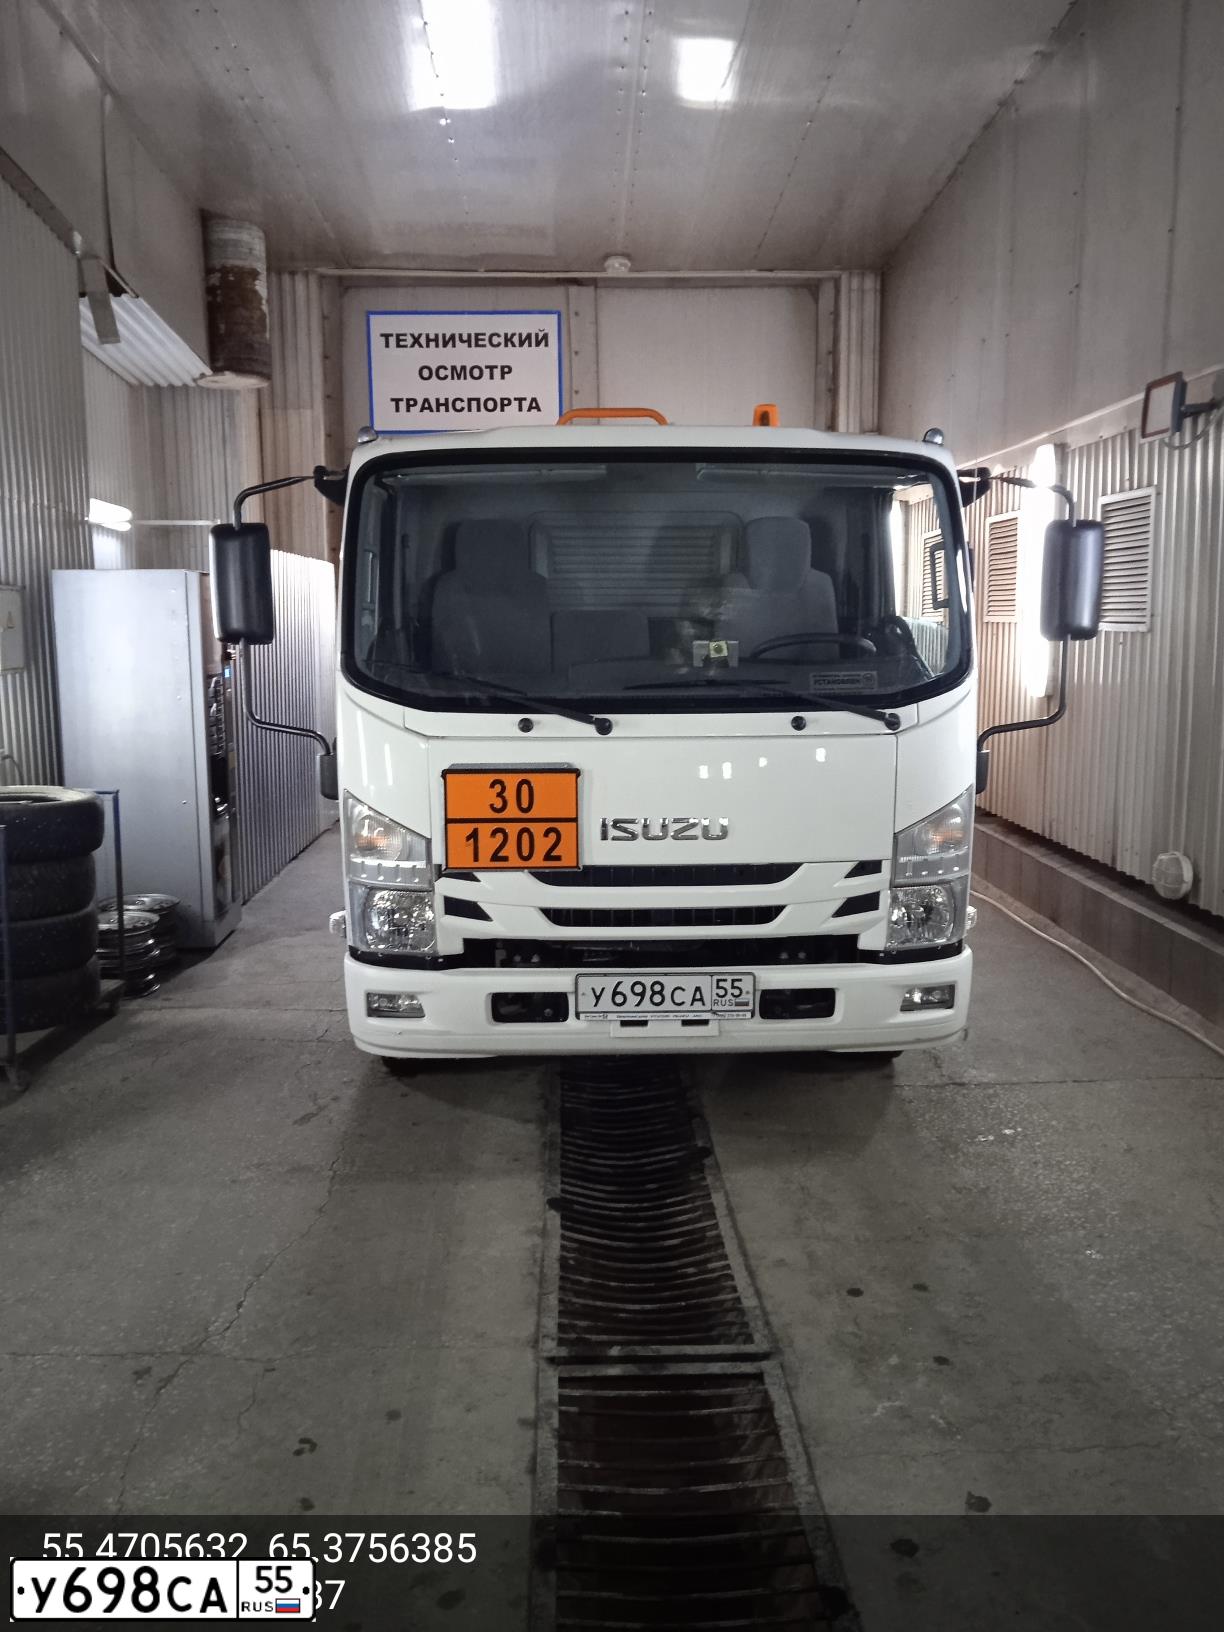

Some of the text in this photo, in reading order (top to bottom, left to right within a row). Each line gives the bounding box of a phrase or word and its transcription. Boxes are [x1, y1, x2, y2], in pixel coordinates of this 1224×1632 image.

[380, 328, 549, 348] ТЕХНИЧЕСКИЙ
[418, 365, 513, 381] ОСМОТР
[390, 397, 542, 413] ТРАНСПОРТА
[489, 779, 534, 813] 30
[600, 817, 729, 841] ISUZU
[465, 827, 562, 862] 1202
[715, 979, 743, 998] 55
